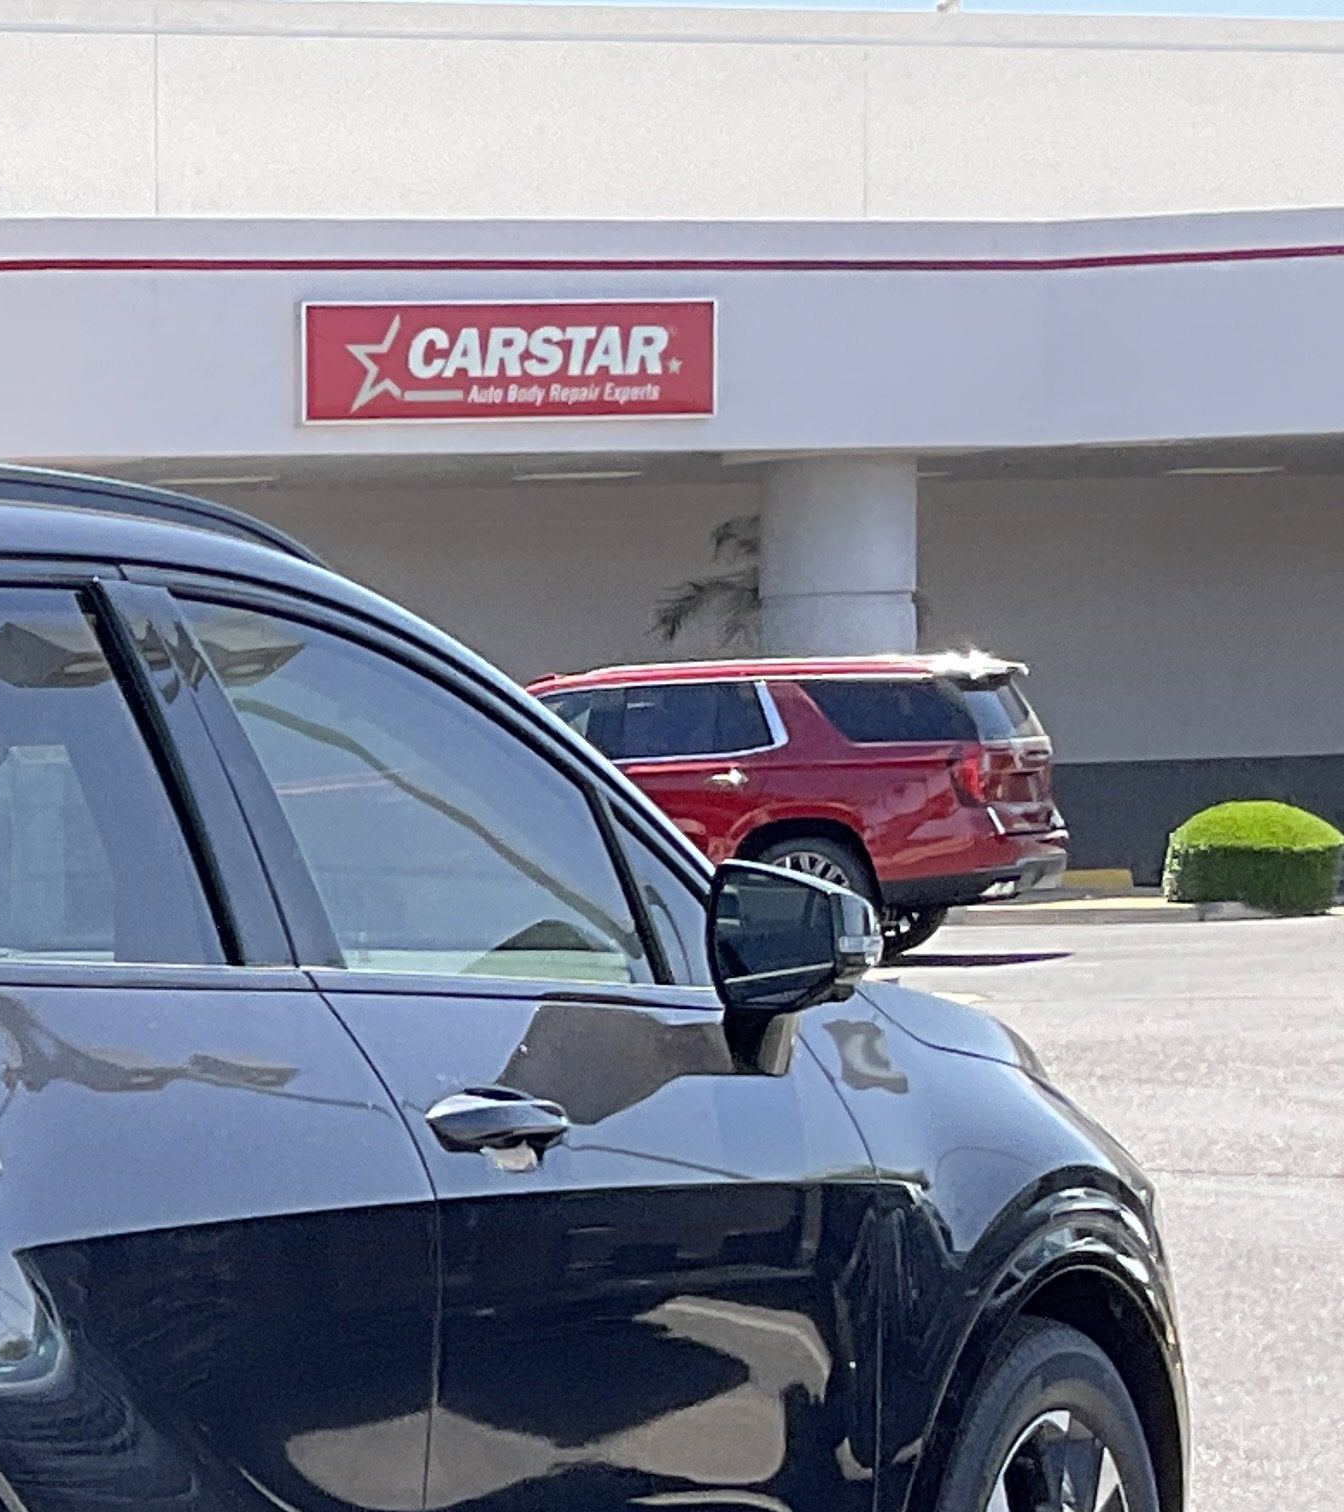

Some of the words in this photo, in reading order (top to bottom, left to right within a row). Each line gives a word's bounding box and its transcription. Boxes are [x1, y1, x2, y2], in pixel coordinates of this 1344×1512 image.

[408, 325, 669, 379] CARSTAR
[467, 384, 503, 403] Auto
[507, 383, 546, 407] Body
[549, 383, 601, 405] Repair
[603, 382, 662, 405] Experts
